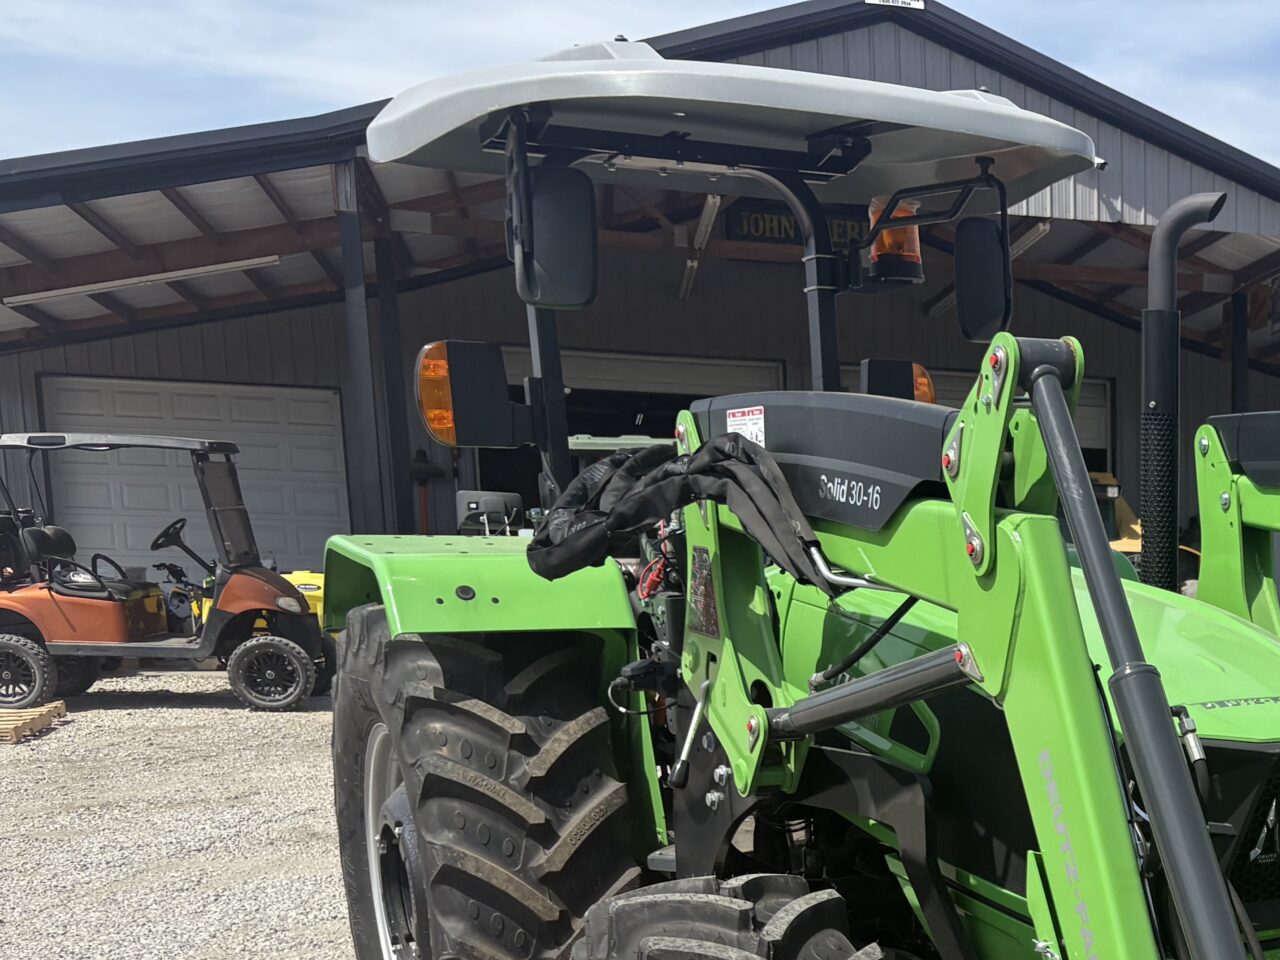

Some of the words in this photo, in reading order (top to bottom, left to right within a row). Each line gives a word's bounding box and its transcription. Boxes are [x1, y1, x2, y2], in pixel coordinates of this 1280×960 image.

[739, 212, 796, 239] JOHN
[819, 474, 848, 502] Solid
[848, 480, 881, 510] 30-16
